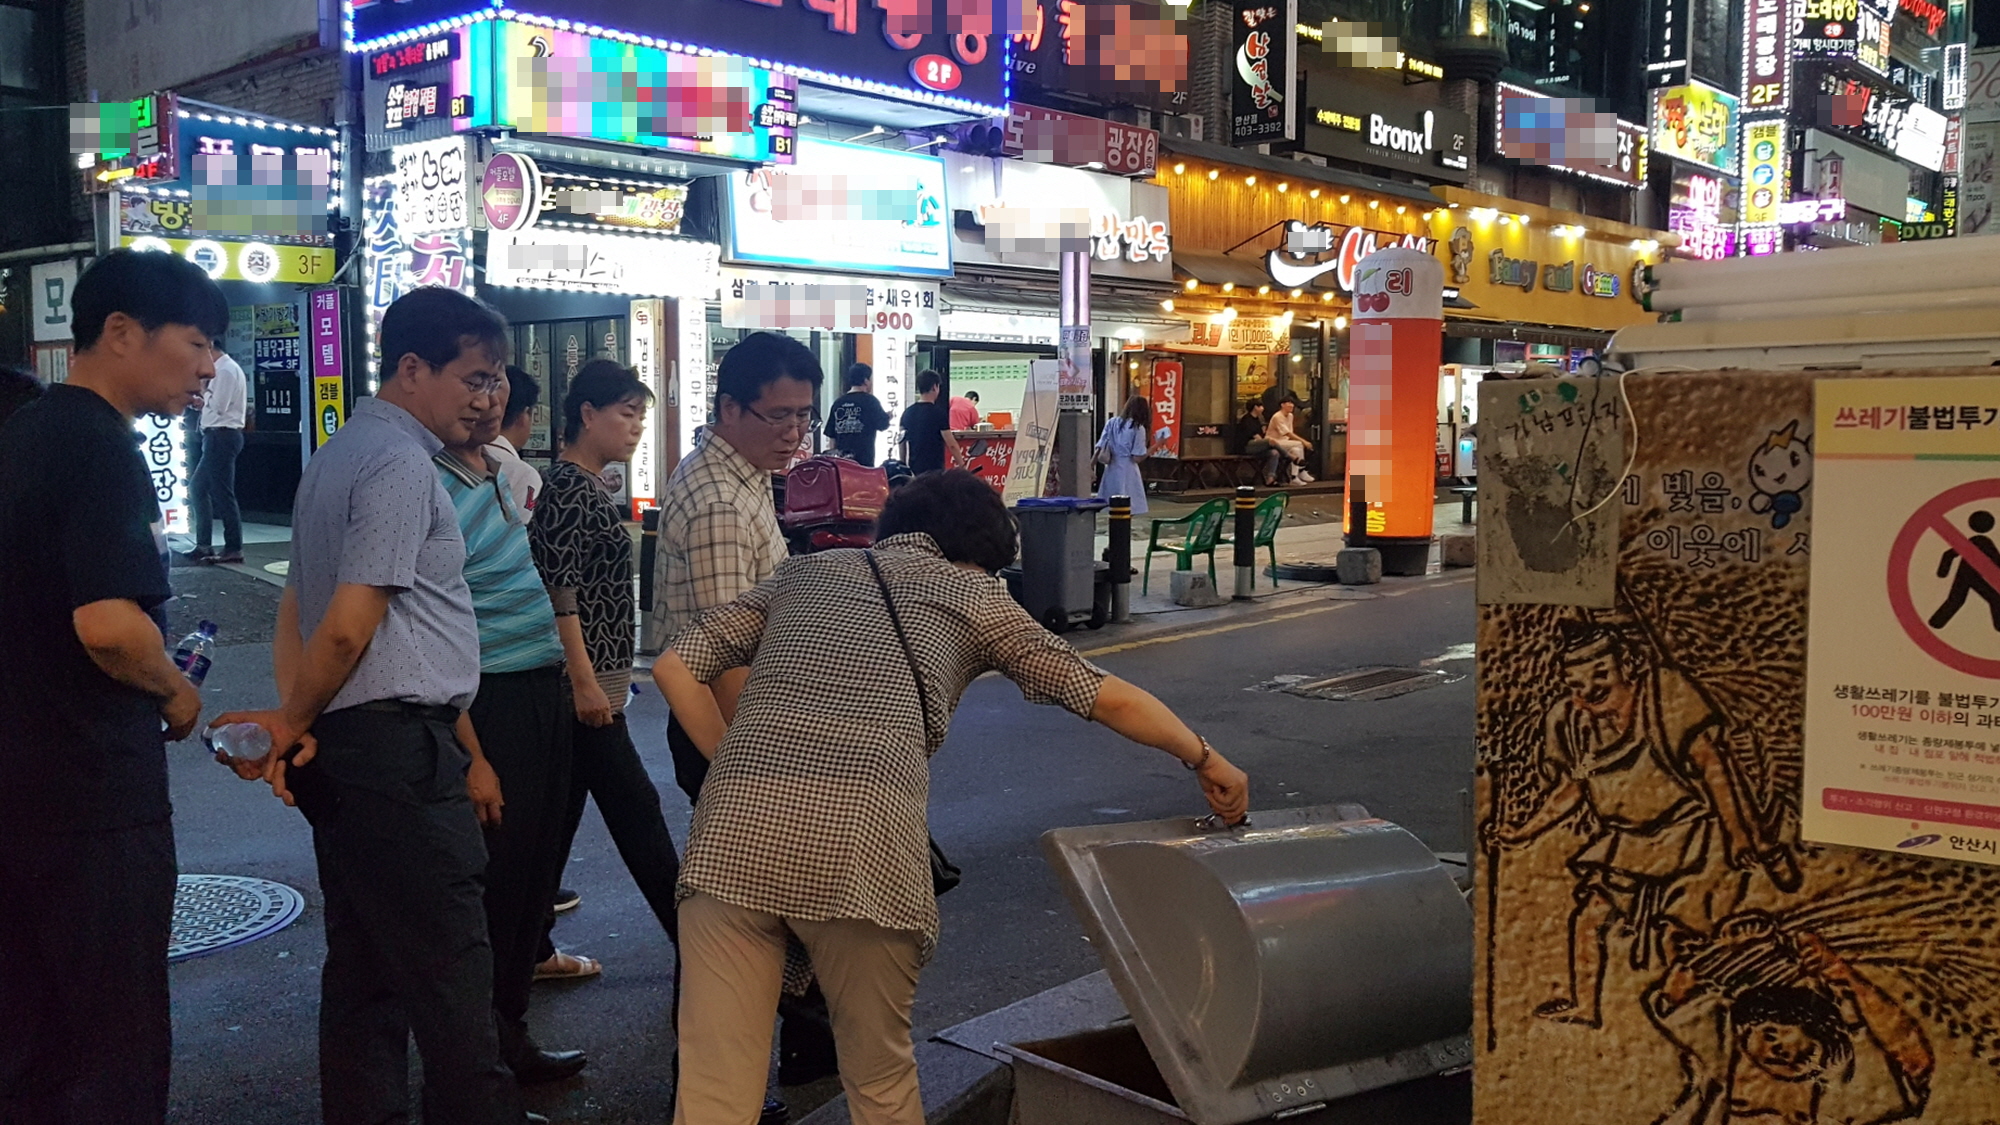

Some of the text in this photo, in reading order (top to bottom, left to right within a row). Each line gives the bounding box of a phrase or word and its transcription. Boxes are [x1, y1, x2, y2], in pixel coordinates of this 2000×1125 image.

[1813, 38, 1856, 52] 항시대기중
[927, 61, 952, 84] 2F
[1009, 53, 1037, 74] ive
[1751, 83, 1780, 104] 2F
[452, 96, 464, 116] B1
[1235, 122, 1282, 137] 403-3392
[776, 137, 791, 154] B1
[1453, 134, 1464, 150] 2F
[1754, 142, 1773, 207] 당구장
[498, 214, 509, 224] 4F
[1092, 212, 1171, 262] 밥만두
[1902, 225, 1945, 239] DVD
[298, 255, 322, 275] 3F
[1544, 260, 1574, 292] and
[1580, 262, 1621, 298] Game
[317, 294, 334, 310] 커플
[862, 311, 913, 332] ,900
[1228, 329, 1239, 343] 1인
[285, 360, 299, 370] 3F
[320, 383, 339, 400] 갬블
[1157, 370, 1178, 425] 냉면
[1662, 470, 1742, 513] 빛을,
[1647, 525, 1761, 569] 이웃에
[1833, 684, 1931, 706] 생활쓰레기를
[1851, 703, 1913, 723] 100만원
[1919, 711, 1970, 727] 이하의
[1857, 731, 1918, 746] 생활쓰레기는
[1922, 736, 1986, 752] 종량제봉투에
[1949, 835, 1997, 854] 안산시
